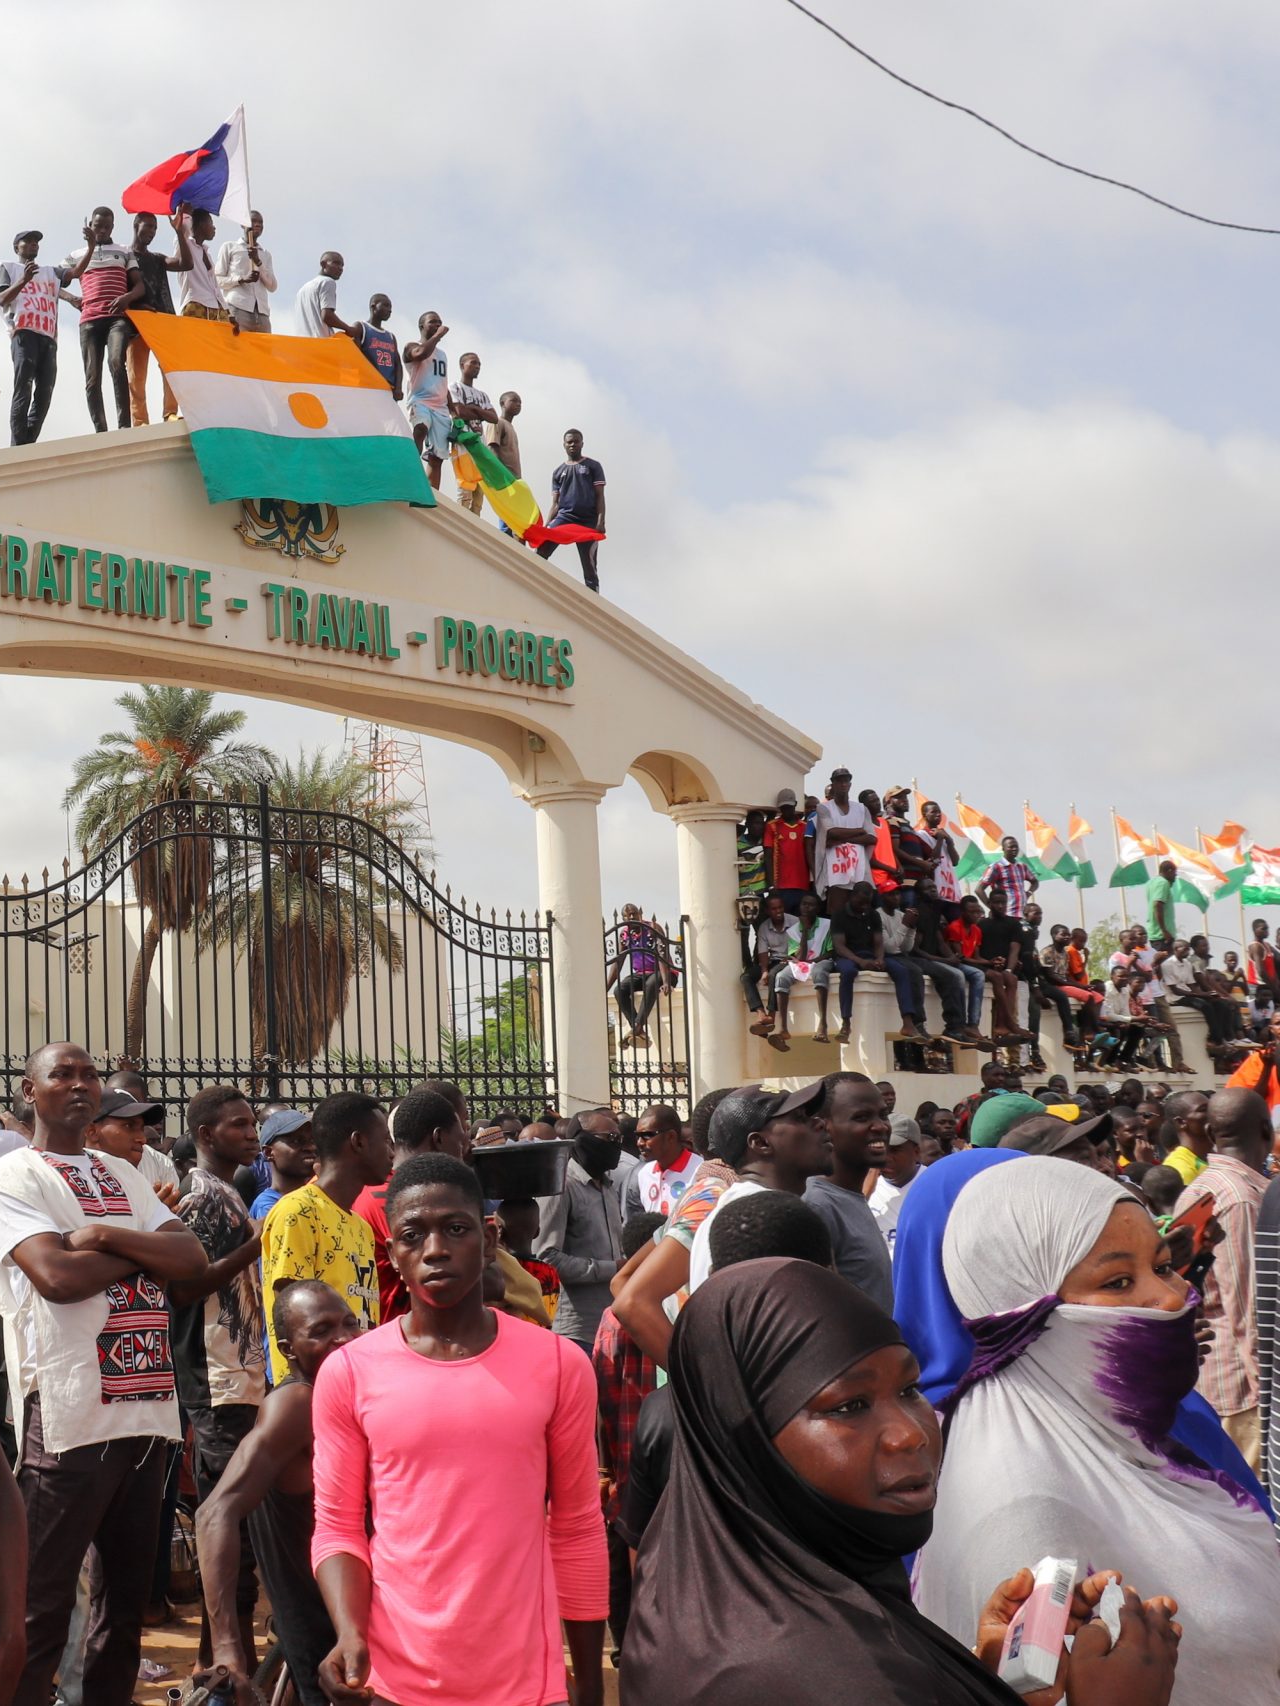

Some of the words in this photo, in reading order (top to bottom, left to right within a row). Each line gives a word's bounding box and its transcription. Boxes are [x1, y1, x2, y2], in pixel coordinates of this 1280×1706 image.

[375, 349, 393, 367] 23
[432, 358, 447, 377] 10
[260, 582, 401, 661] TRAVAIL
[434, 615, 576, 690] PROGRES
